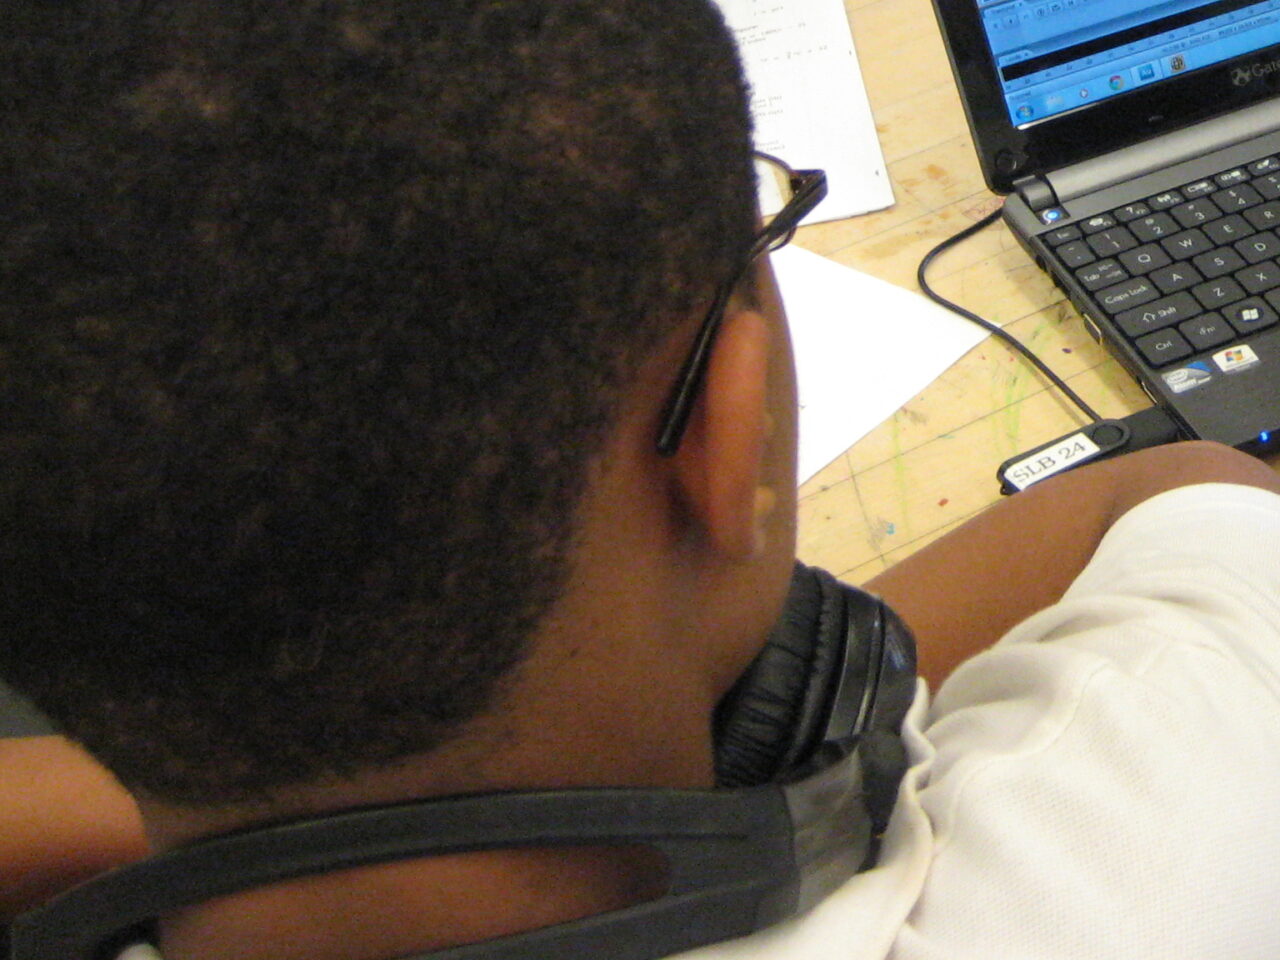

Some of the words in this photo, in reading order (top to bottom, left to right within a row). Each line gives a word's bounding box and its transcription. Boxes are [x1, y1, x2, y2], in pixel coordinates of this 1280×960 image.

[1264, 210, 1275, 220] R
[1223, 224, 1234, 233] E
[1179, 238, 1193, 248] W
[1254, 243, 1266, 252] D
[1214, 257, 1225, 266] S
[1172, 273, 1183, 282] A
[1256, 273, 1268, 282] X
[1105, 293, 1129, 305] Caps
[1130, 284, 1149, 296] Lock
[1213, 287, 1225, 297] Z
[1158, 306, 1177, 318] Shift
[1155, 341, 1173, 351] Ctrl
[1013, 456, 1057, 482] SLB
[1058, 441, 1087, 460] 24
